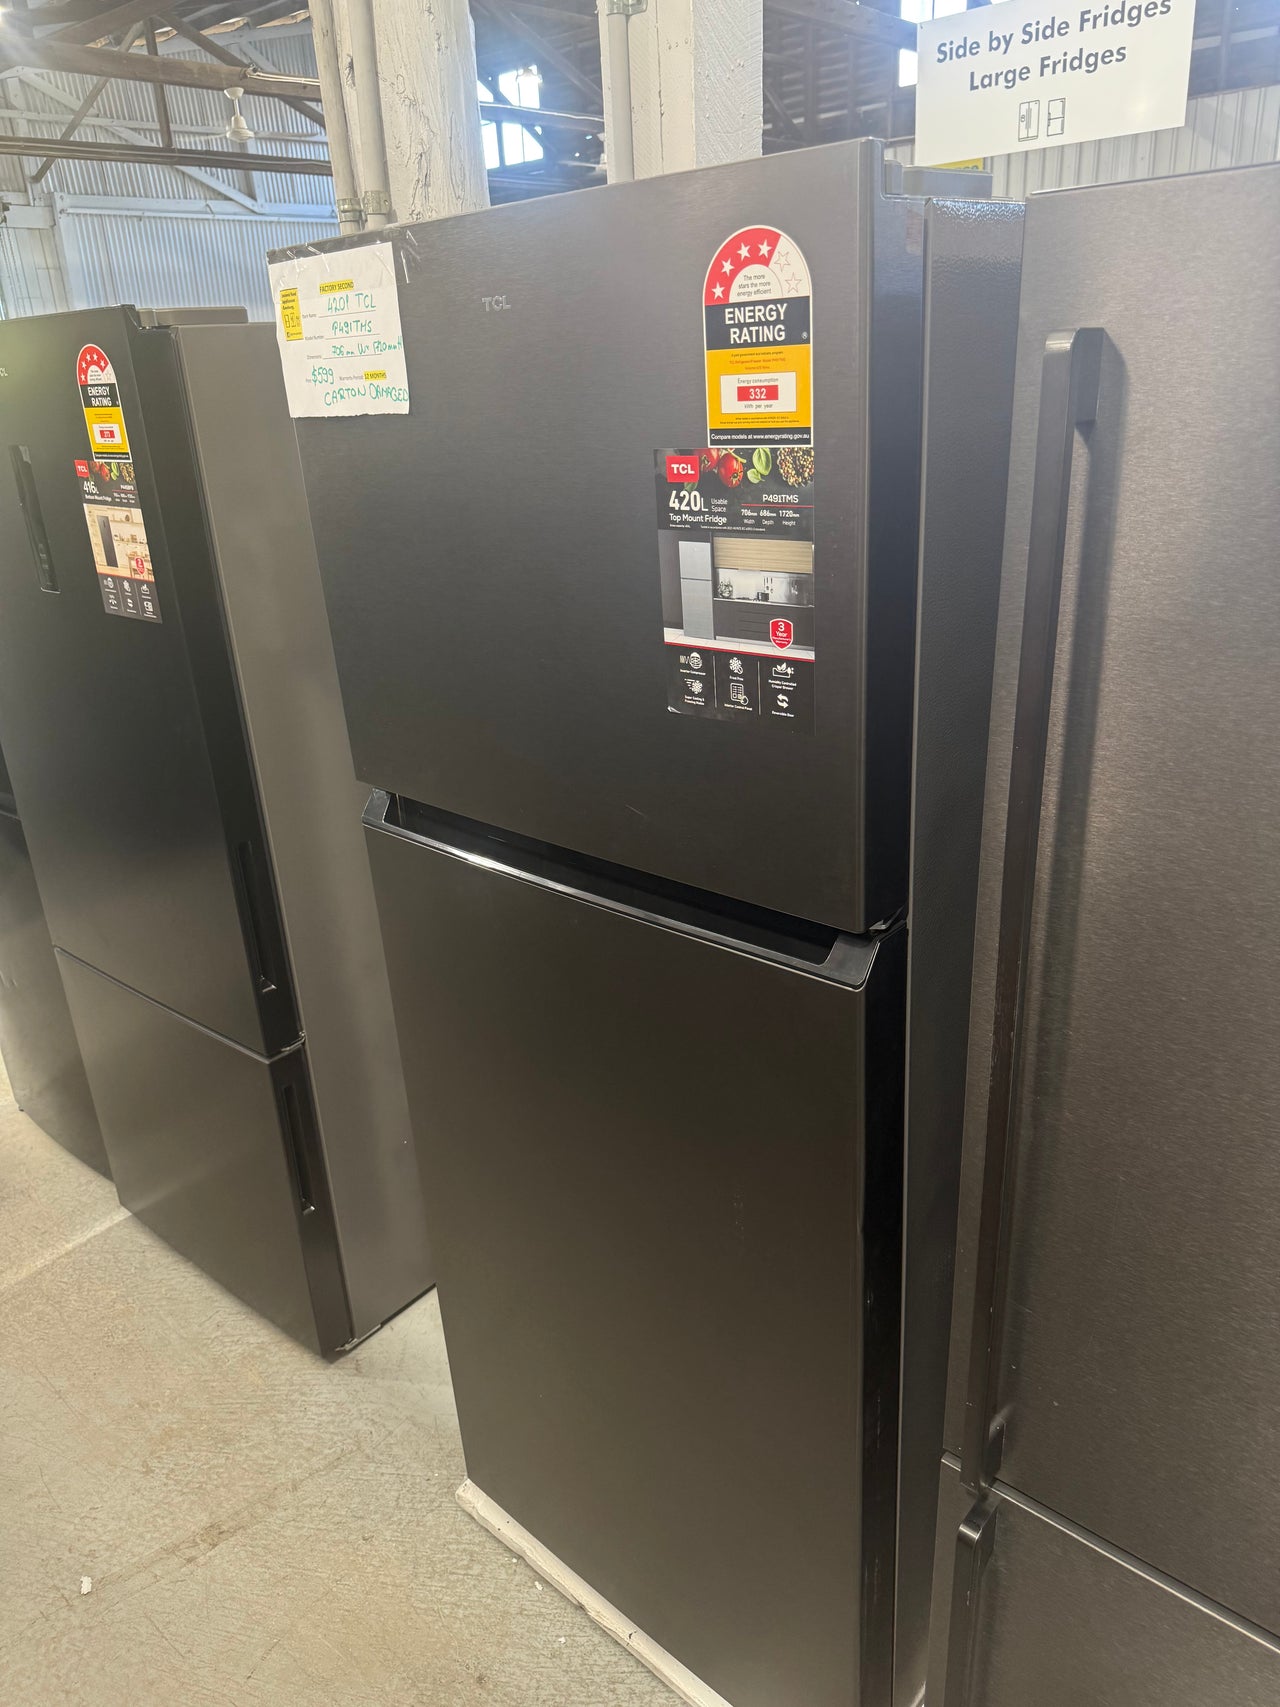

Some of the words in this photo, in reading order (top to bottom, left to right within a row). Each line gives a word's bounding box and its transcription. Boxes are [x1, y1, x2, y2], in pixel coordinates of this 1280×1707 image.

[936, 36, 981, 64] Side
[988, 30, 1015, 55] by
[1021, 16, 1070, 45] Side
[1079, 0, 1172, 33] Fridges
[969, 66, 1031, 92] Large
[1039, 46, 1127, 77] Fridges
[320, 283, 337, 293] FACTORY
[337, 281, 354, 290] SECOND
[355, 293, 376, 309] TCL
[481, 295, 512, 312] TCL
[724, 303, 788, 325] ENERGY
[729, 324, 786, 344] RATING
[312, 364, 334, 387] $599
[737, 377, 752, 385] Energy
[87, 386, 110, 396] ENERGY
[324, 384, 367, 406] CARTON
[749, 387, 767, 400] 332
[91, 397, 112, 407] RATING
[711, 433, 731, 441] Compare
[77, 465, 88, 473] TCL
[671, 463, 695, 475] TCL
[762, 494, 799, 504] P491TMS
[712, 505, 727, 513] Space
[669, 513, 681, 524] Top
[682, 513, 704, 523] Mount
[704, 514, 727, 526] Fridge
[778, 621, 785, 632] 3
[775, 630, 788, 638] Year
